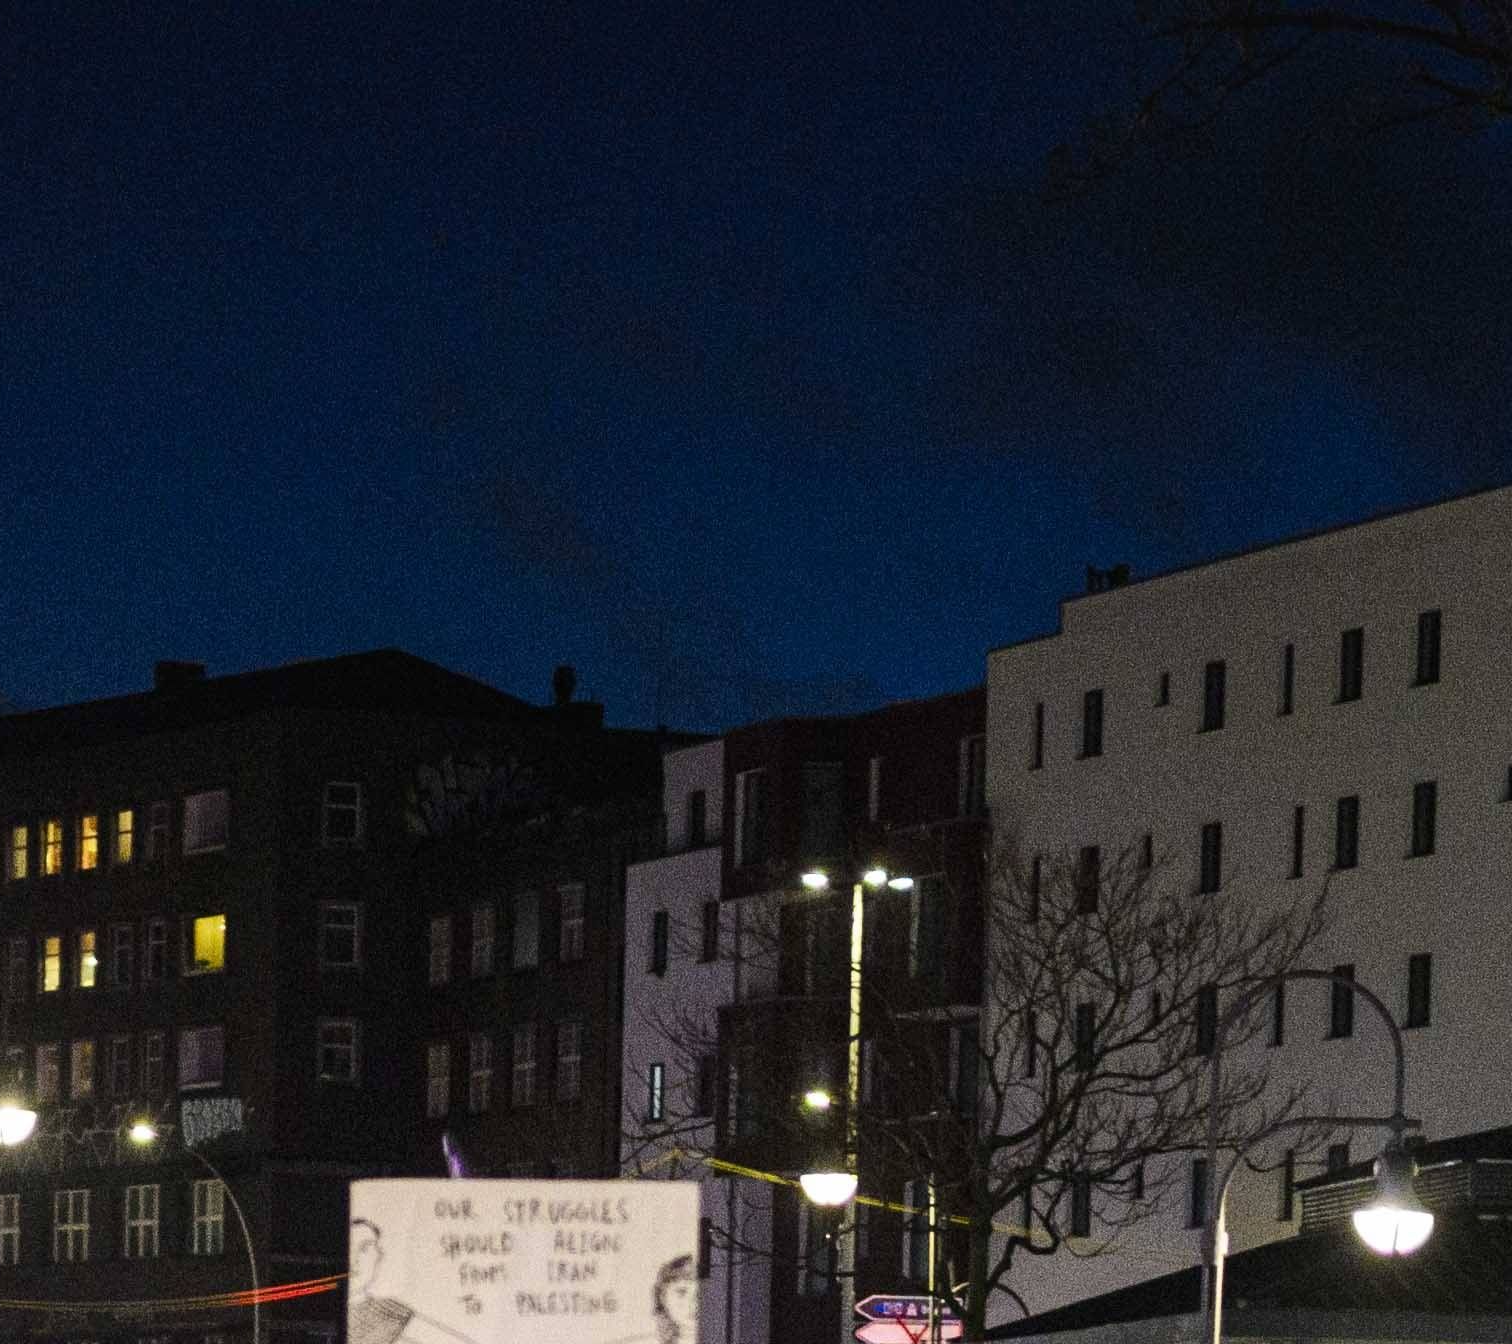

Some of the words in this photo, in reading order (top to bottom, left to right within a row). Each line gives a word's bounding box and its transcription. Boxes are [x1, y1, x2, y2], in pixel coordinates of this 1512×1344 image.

[433, 1198, 476, 1220] OUR
[502, 1197, 630, 1225] STRUGGLES
[439, 1232, 514, 1260] SHOULD
[553, 1232, 623, 1254] ALIGN
[546, 1260, 598, 1283] IRAN
[514, 1290, 620, 1317] PALESTINE
